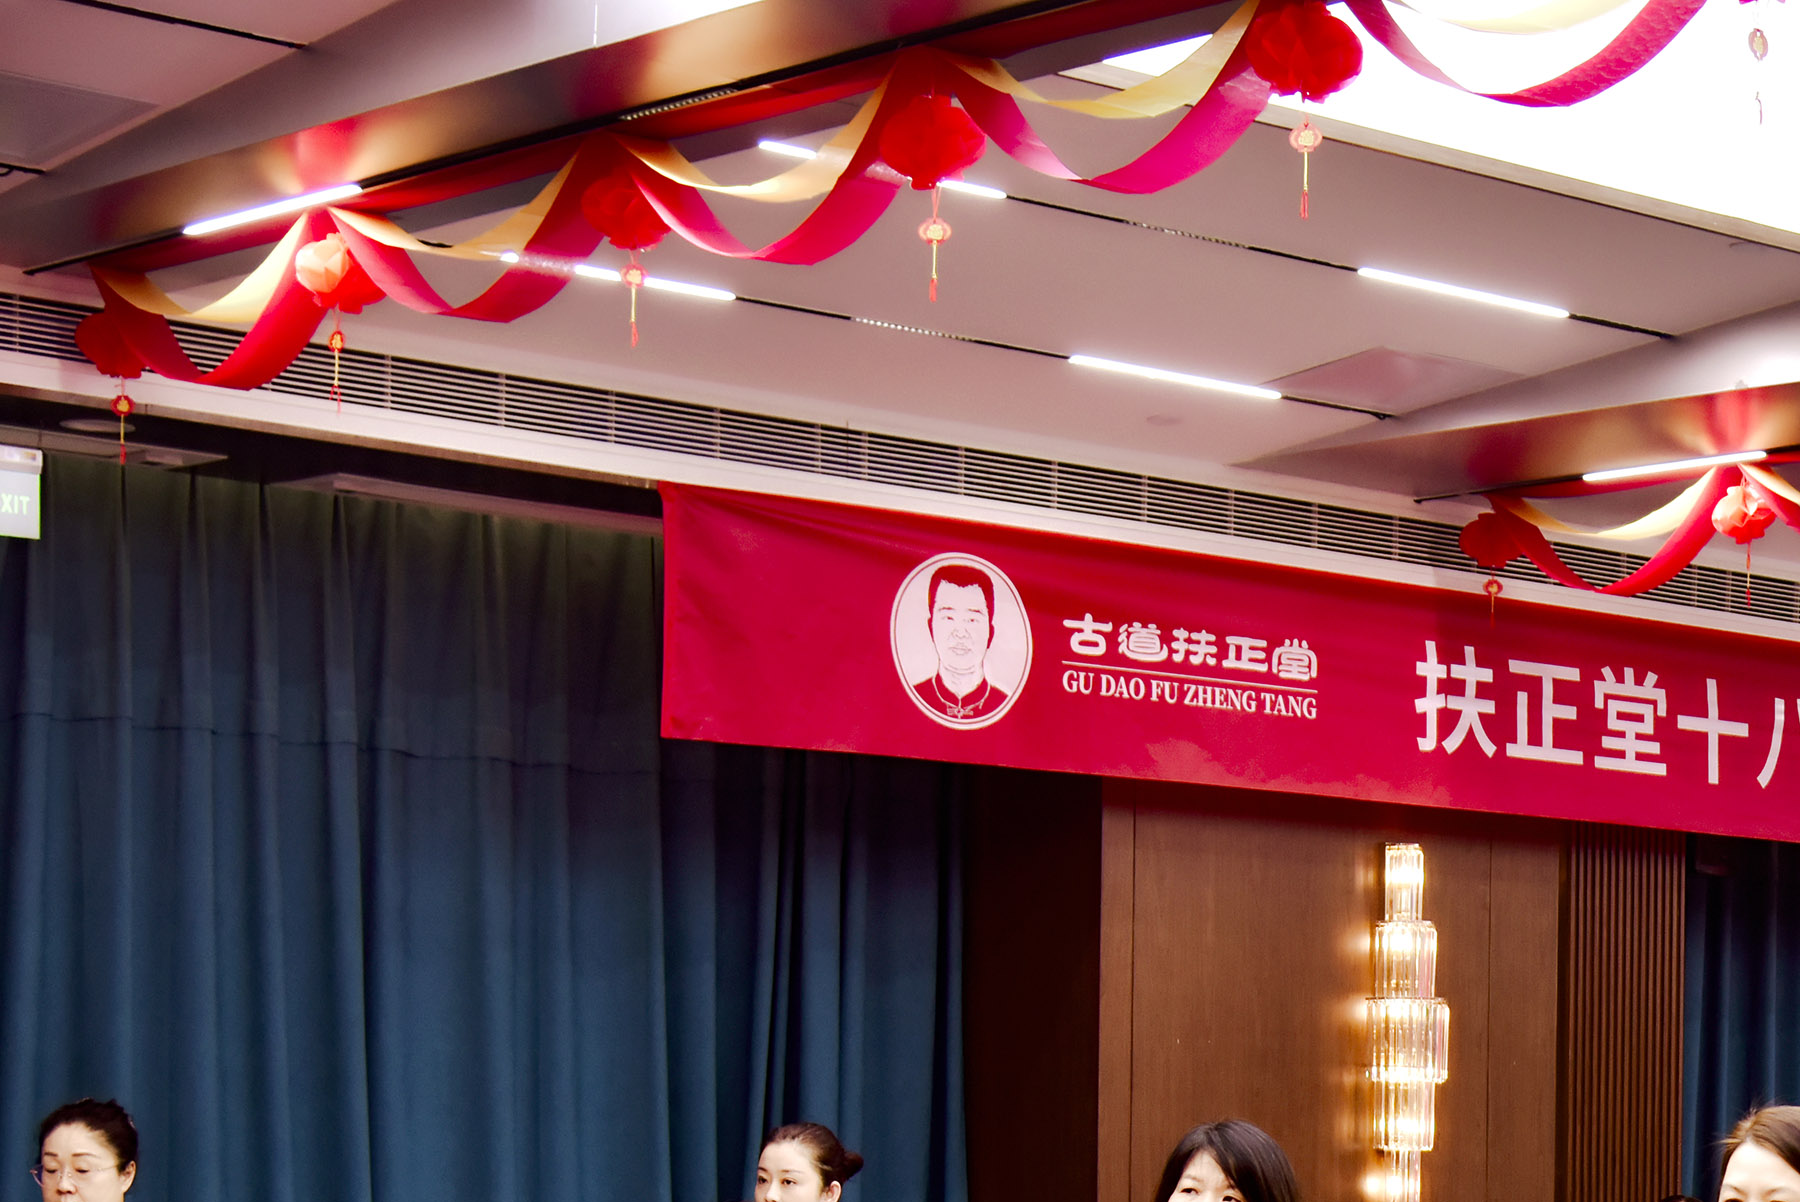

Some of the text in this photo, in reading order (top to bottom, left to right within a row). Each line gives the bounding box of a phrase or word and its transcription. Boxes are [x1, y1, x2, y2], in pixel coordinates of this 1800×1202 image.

[0, 493, 30, 515] XIT
[1062, 612, 1318, 682] 古道扶正堂
[1062, 670, 1318, 720] GU DAO FU ZHENG TANG
